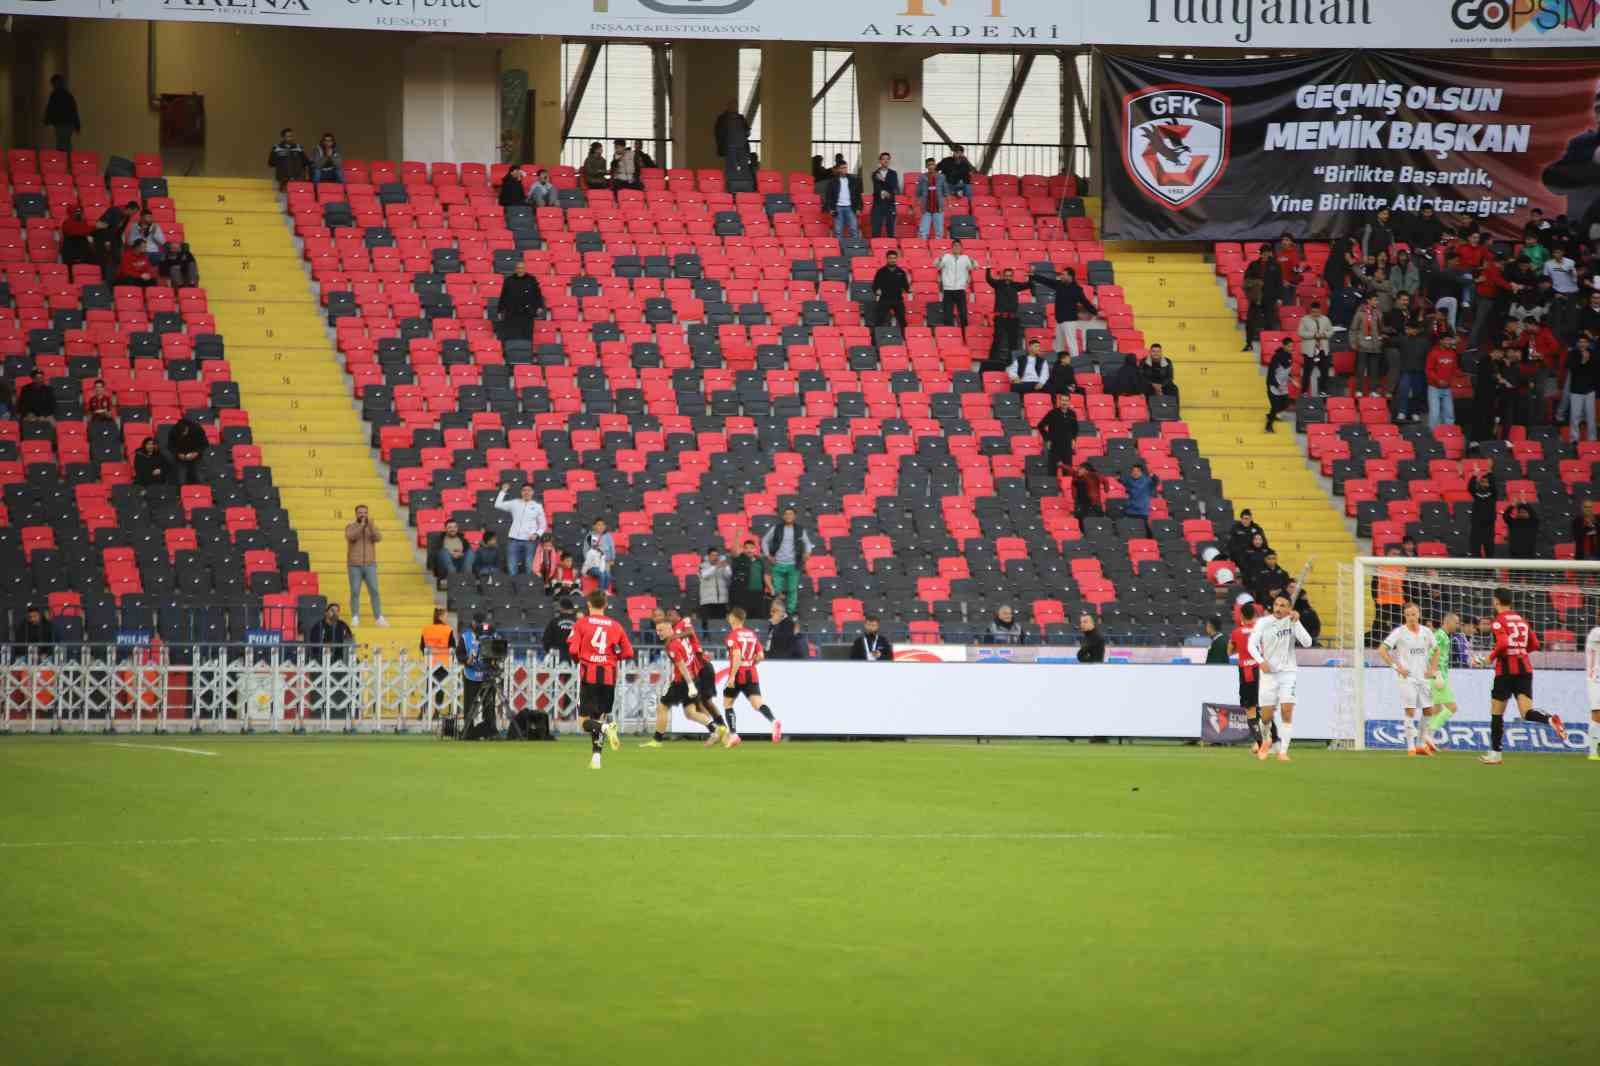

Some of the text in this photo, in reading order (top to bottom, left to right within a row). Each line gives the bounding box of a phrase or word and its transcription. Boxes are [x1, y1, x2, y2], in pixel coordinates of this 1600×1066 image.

[375, 16, 452, 28] RESORT
[1149, 95, 1201, 116] GFK
[1296, 79, 1504, 115] GEÇMİŞ OLSUN
[1263, 114, 1532, 160] MEMİK BAŞKAN
[1399, 165, 1493, 190] Başardık,
[1269, 193, 1314, 213] Yine
[1317, 193, 1388, 212] Birlikte
[590, 626, 608, 655] 4
[1507, 622, 1529, 648] 23
[737, 637, 757, 659] 77
